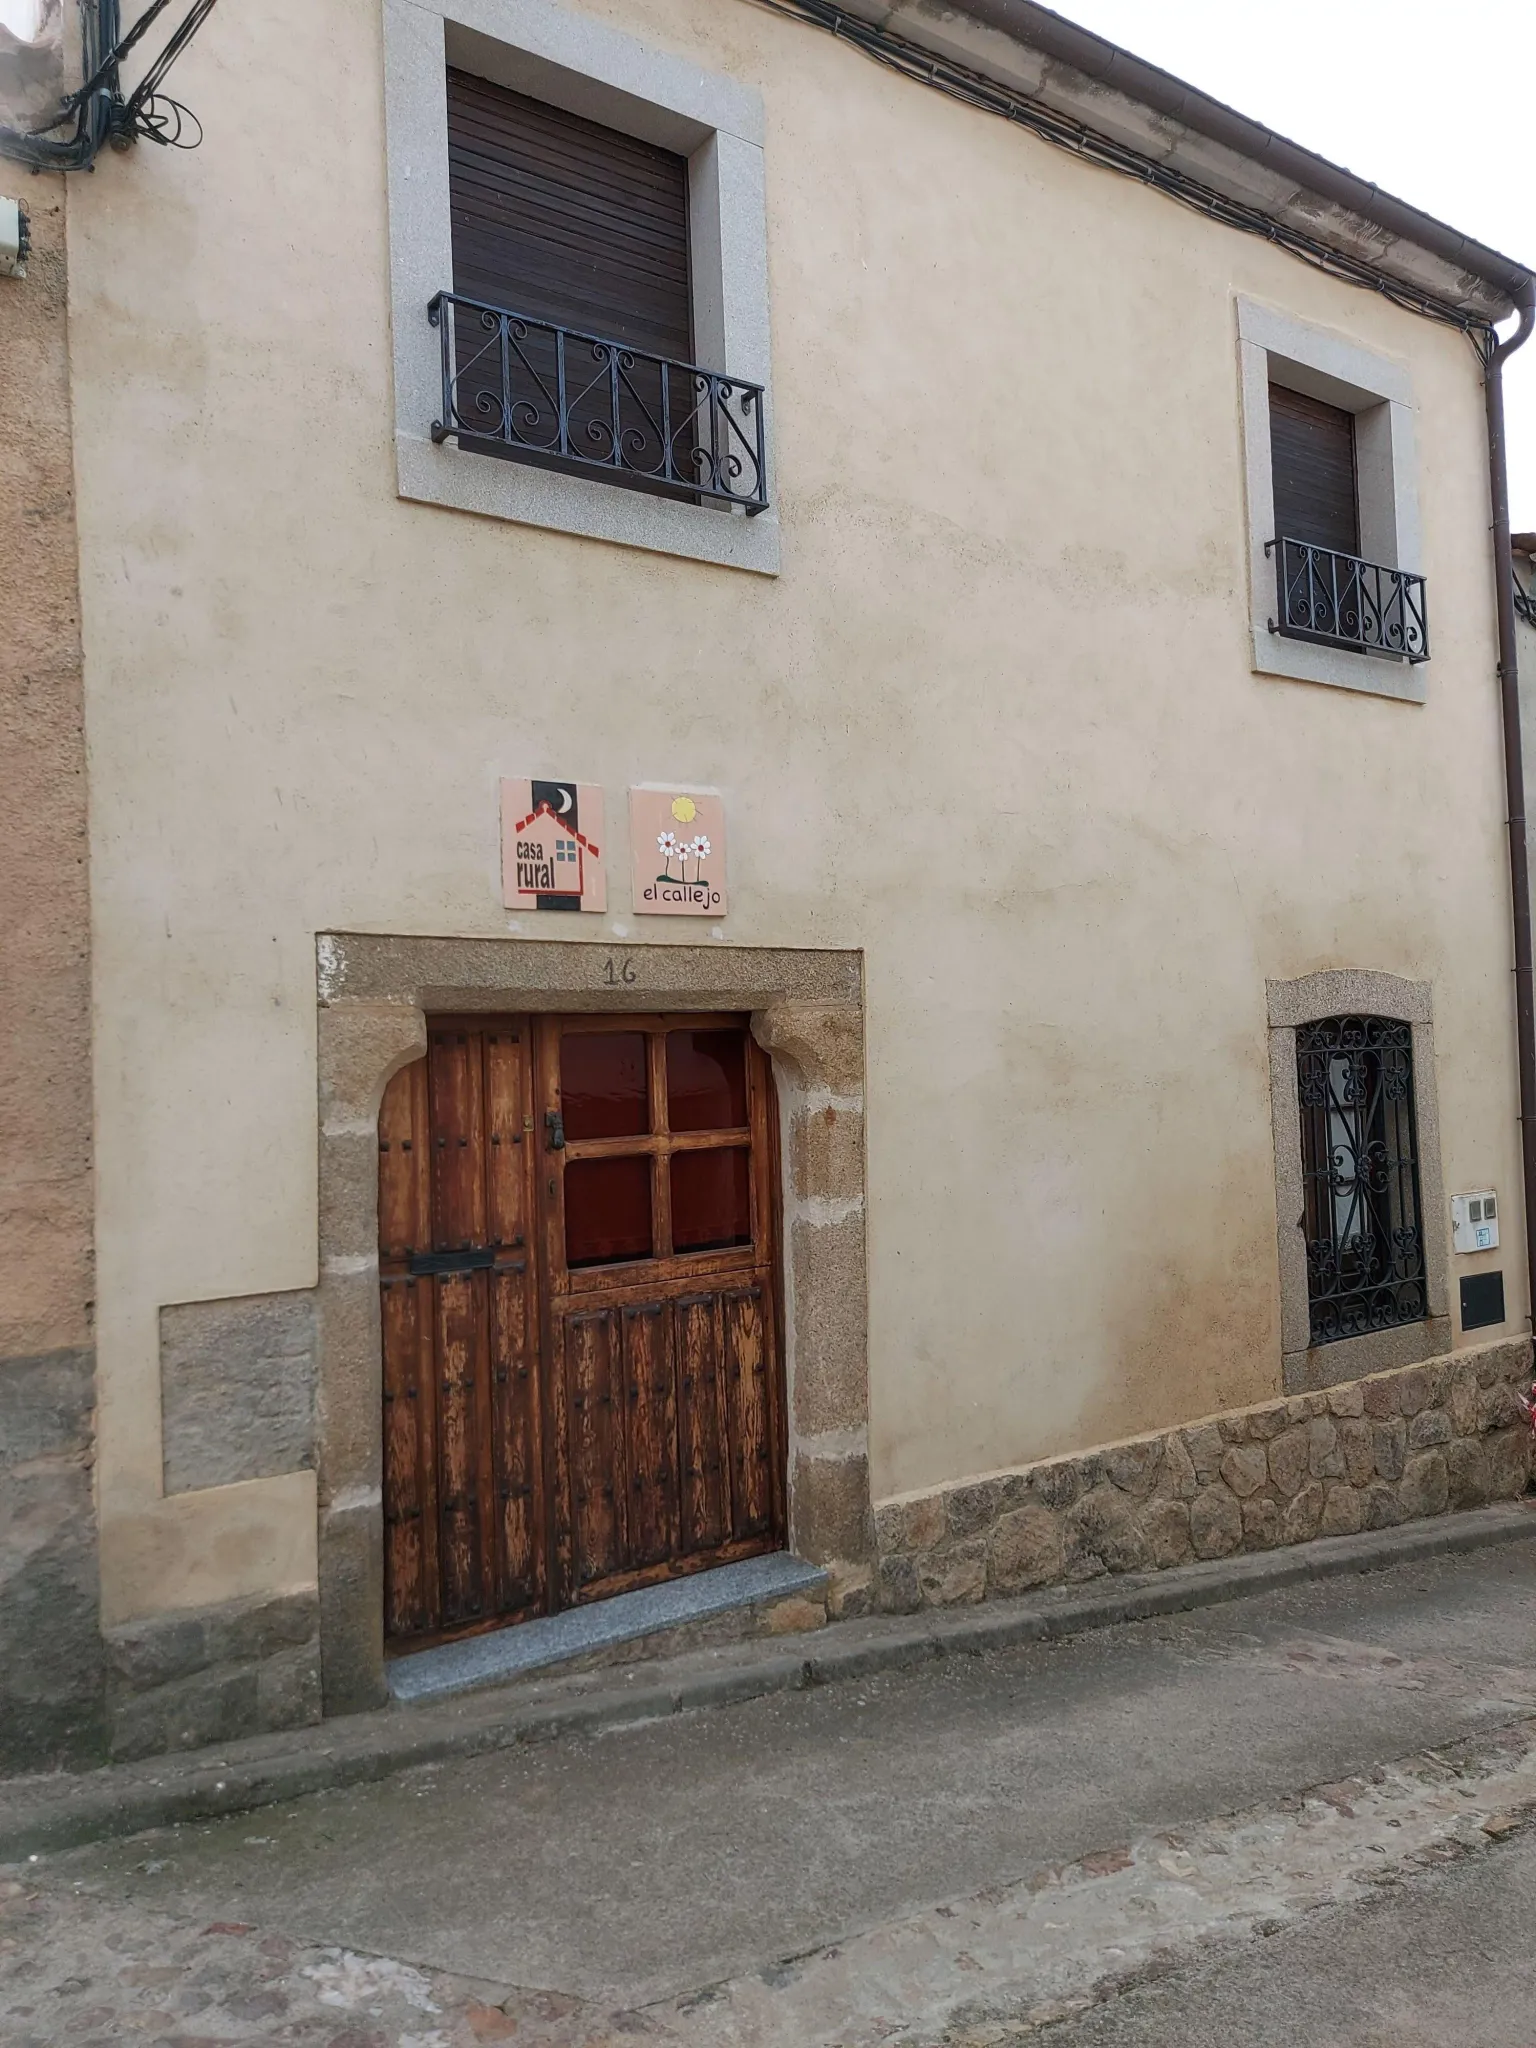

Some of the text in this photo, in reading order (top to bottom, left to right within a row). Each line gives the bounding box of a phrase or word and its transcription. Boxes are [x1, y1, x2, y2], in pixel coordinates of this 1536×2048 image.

[516, 840, 544, 861] casa
[516, 856, 556, 889] rural
[643, 883, 721, 910] el callejo
[602, 957, 637, 986] 16
